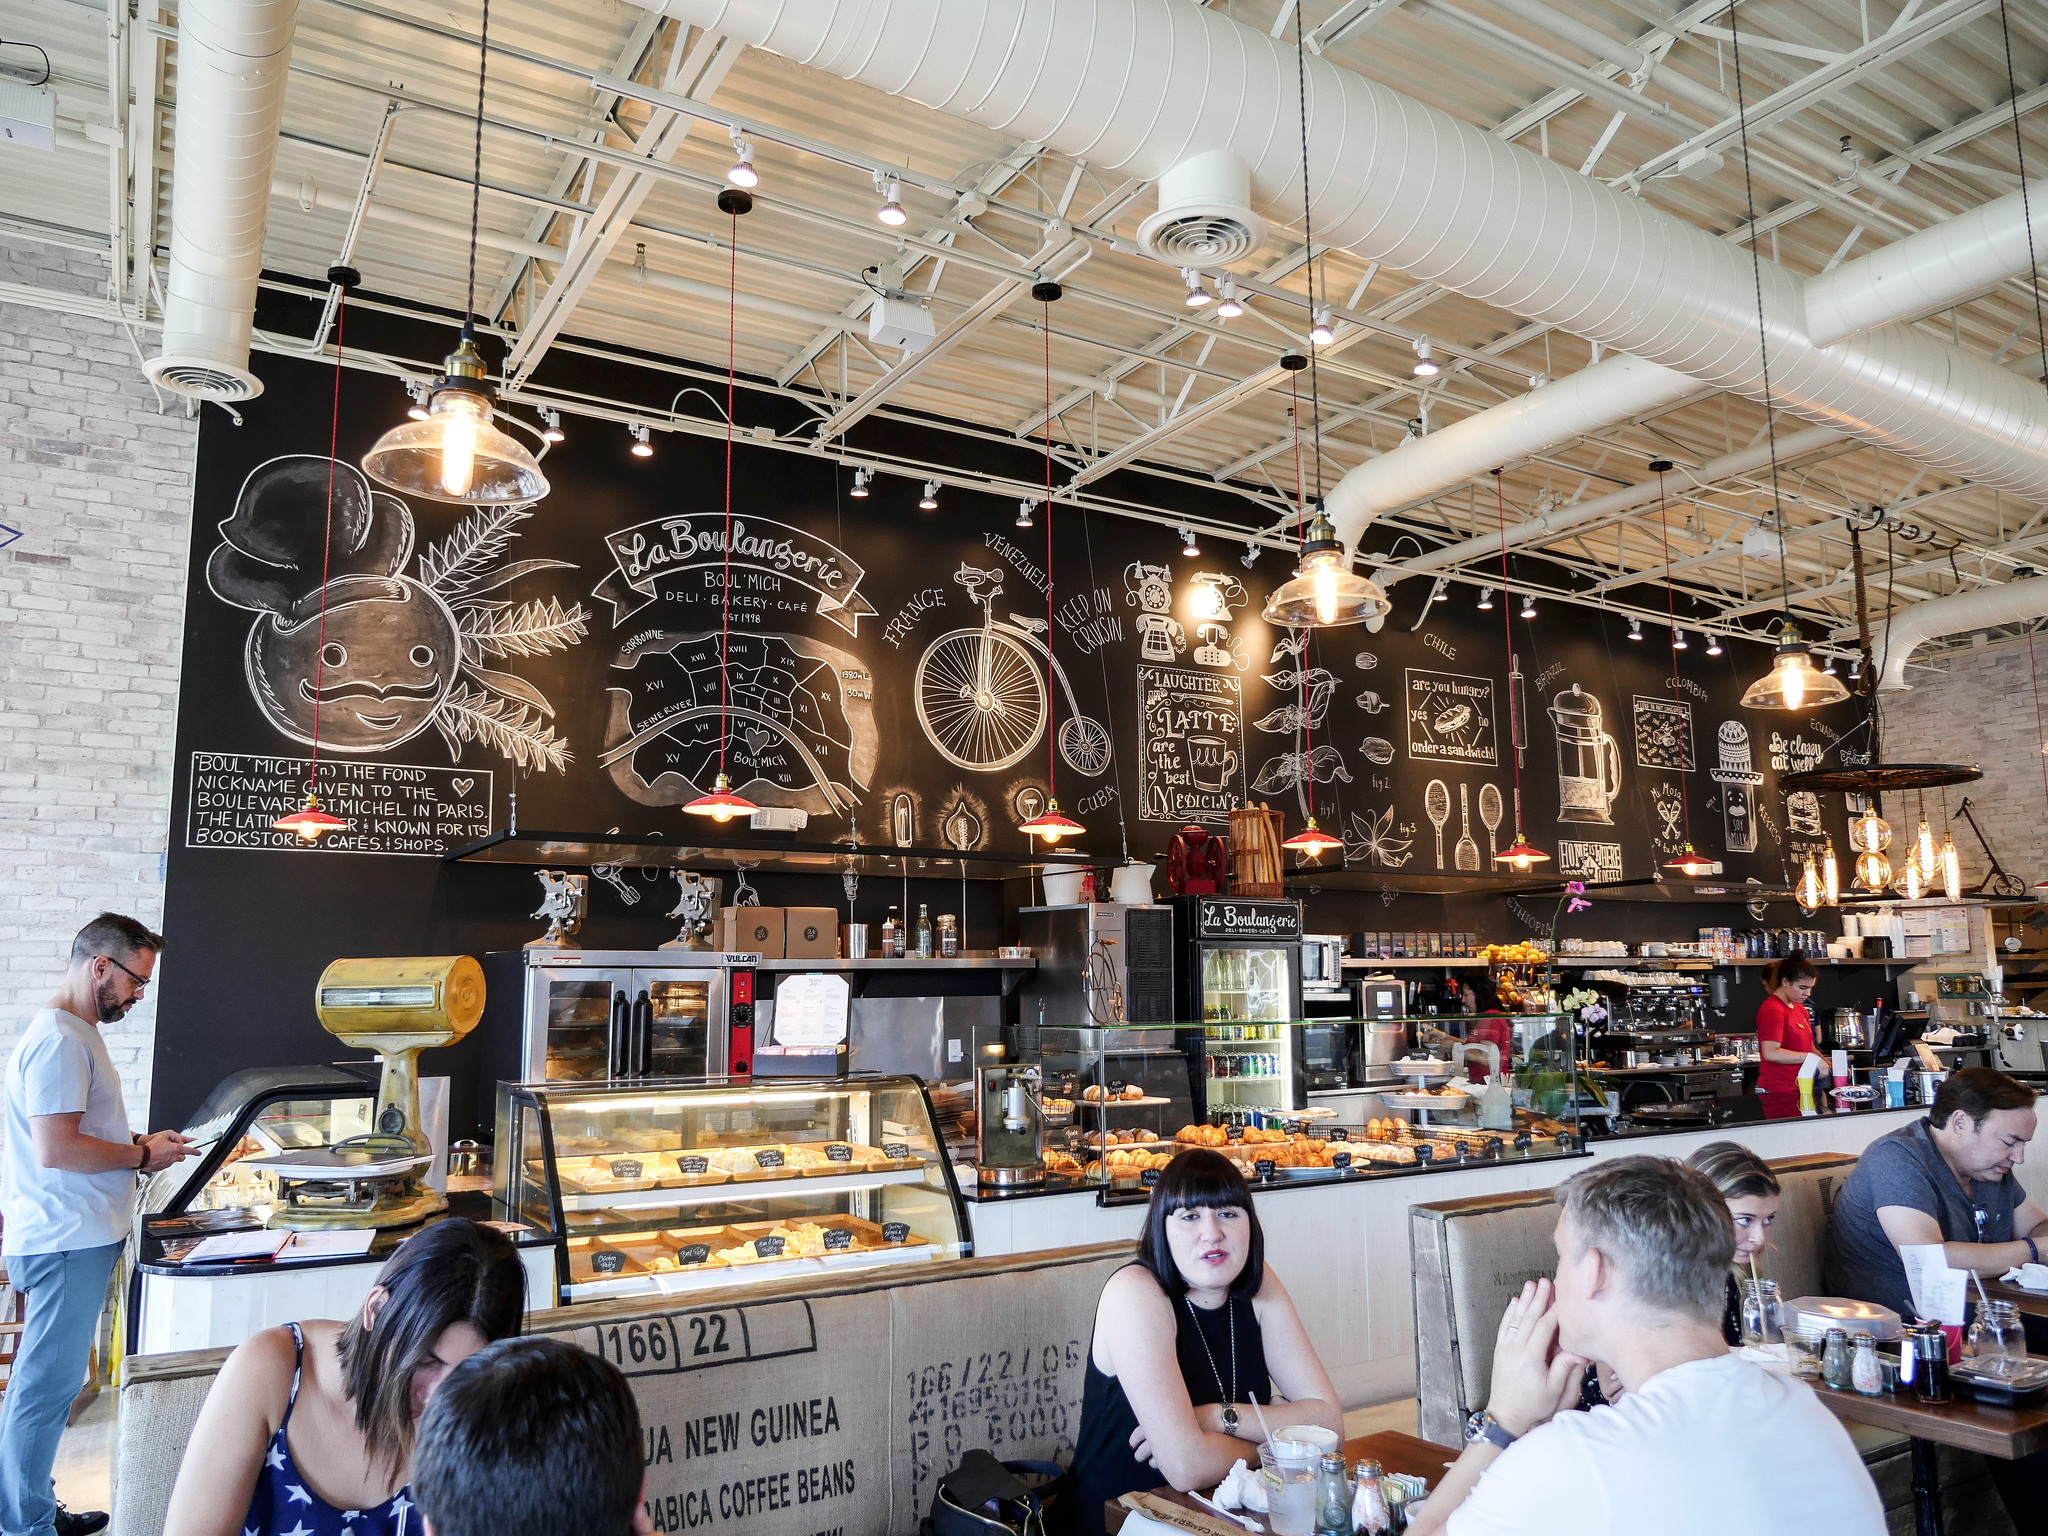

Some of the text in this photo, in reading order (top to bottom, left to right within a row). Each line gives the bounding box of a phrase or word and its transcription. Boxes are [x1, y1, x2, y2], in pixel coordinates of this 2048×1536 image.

[618, 519, 842, 589] La Boulangerie
[983, 531, 1056, 601] VENEZUELA
[666, 591, 808, 612] DELI BAKERY CAFÉ
[1053, 587, 1112, 634] KEEP ON
[741, 613, 761, 624] 1998
[882, 588, 946, 650] FRANCE
[621, 630, 664, 654] SORBONNE
[728, 645, 748, 653] XVIII
[1423, 633, 1457, 660] CHILE
[690, 653, 706, 663] XVII
[780, 656, 795, 667] XIX
[736, 672, 744, 680] IX
[772, 676, 779, 684] X
[1154, 672, 1223, 693] LAUGHTER
[1534, 661, 1567, 692] BRAZIL
[646, 679, 665, 692] XVI
[703, 682, 717, 693] VIII
[1412, 679, 1490, 699] are you hungry?
[1665, 676, 1709, 702] COLOMBIA
[821, 692, 831, 701] XX
[637, 699, 693, 732] SEINE RIVER
[799, 704, 808, 713] XI
[737, 720, 746, 728] VI
[1157, 708, 1238, 738] LATTE
[1411, 709, 1489, 727] yes no
[694, 723, 709, 732] VII
[772, 733, 778, 742] V
[1769, 731, 1788, 753] Be
[815, 744, 828, 756] XII
[1152, 741, 1176, 753] are
[1411, 741, 1439, 754] order
[1440, 746, 1446, 754] a
[665, 753, 680, 764] XV
[1158, 754, 1181, 770] the
[1771, 752, 1790, 771] eat
[342, 764, 376, 780] THE
[382, 767, 427, 782] FOND
[778, 773, 792, 783] XIII
[1163, 770, 1191, 785] best
[197, 775, 439, 801] NICKNAME GIVEN TO THE
[1372, 774, 1391, 792] fig.2
[1077, 784, 1119, 815] CUBA
[413, 804, 430, 817] IN
[195, 811, 232, 827] THE
[374, 819, 431, 835] KNOWN
[436, 823, 464, 836] FOR
[467, 825, 489, 838] ITS
[1733, 819, 1744, 832] SOY
[1758, 804, 1781, 845] MEXICO
[394, 838, 449, 851] SHOPS.
[1730, 832, 1747, 846] MILK
[1204, 905, 1297, 934] La Boulangerie
[1506, 896, 1553, 936] ETHIOPIA
[726, 955, 757, 963] VULCAN
[608, 1314, 730, 1365] 166 22
[686, 1412, 740, 1459] NEW
[750, 1396, 840, 1447] GUINEA
[719, 1472, 791, 1519] COFFEE
[797, 1458, 856, 1505] BEANS
